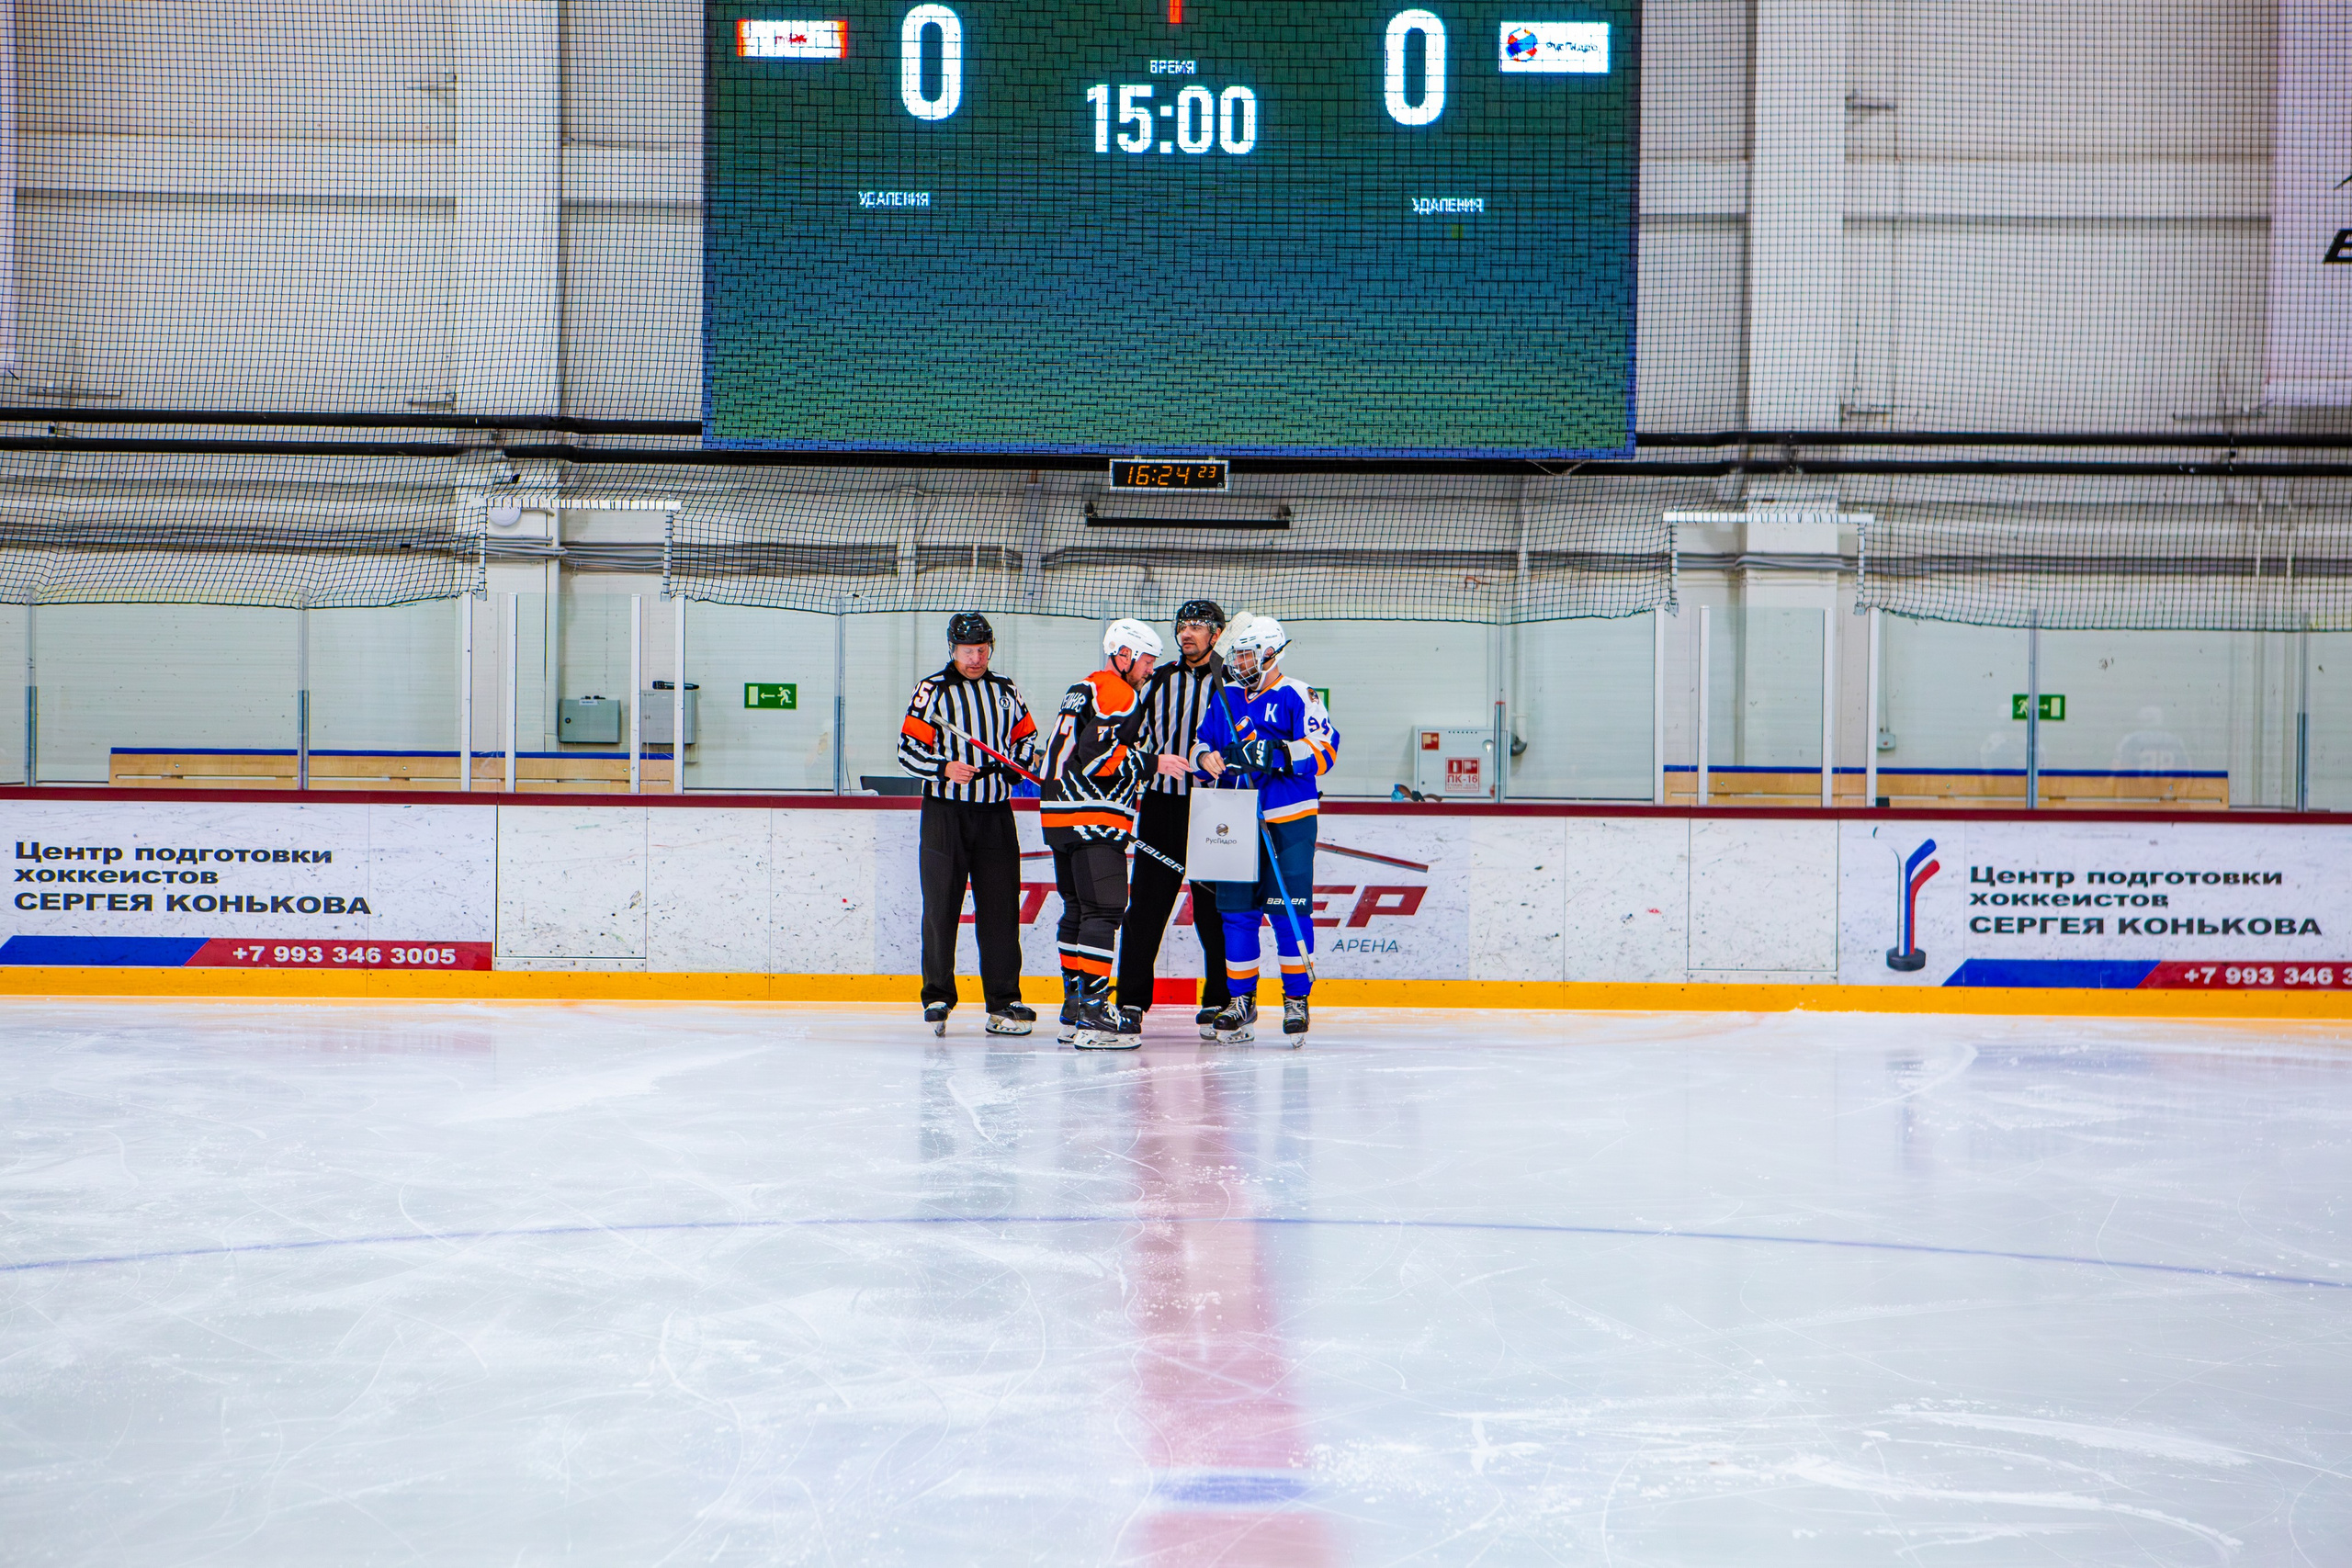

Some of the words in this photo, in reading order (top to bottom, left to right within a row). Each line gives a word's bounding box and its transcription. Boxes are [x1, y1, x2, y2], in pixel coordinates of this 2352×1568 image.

[900, 4, 963, 120] 0
[1149, 60, 1196, 74] ВРЕМЯ
[1384, 8, 1447, 126] 0
[1087, 84, 1257, 154] 15:00
[858, 191, 931, 209] УДАЛЕНИЯ
[1126, 465, 1191, 486] 16:24
[1197, 466, 1216, 479] 23
[1205, 837, 1238, 845] РусГидро
[17, 841, 124, 865] Центр
[135, 847, 333, 865] подготовки
[15, 868, 220, 885] хоккеистов
[1970, 866, 2075, 888] Центр
[2086, 872, 2283, 887] подготовки
[15, 892, 153, 912] СЕРГЕЯ
[167, 894, 372, 915] КОНЬКОВА
[1970, 893, 2170, 908] хоккеистов
[1969, 917, 2105, 935] СЕРГЕЯ
[2117, 917, 2323, 936] КОНЬКОВА
[232, 944, 266, 962] +7
[274, 945, 323, 963] 993
[332, 946, 381, 964] 346
[390, 947, 457, 964] 3005
[1331, 939, 1399, 953] АРЕНА
[2184, 967, 2217, 984] +7
[2225, 967, 2275, 985] 993
[2284, 967, 2334, 985] 346
